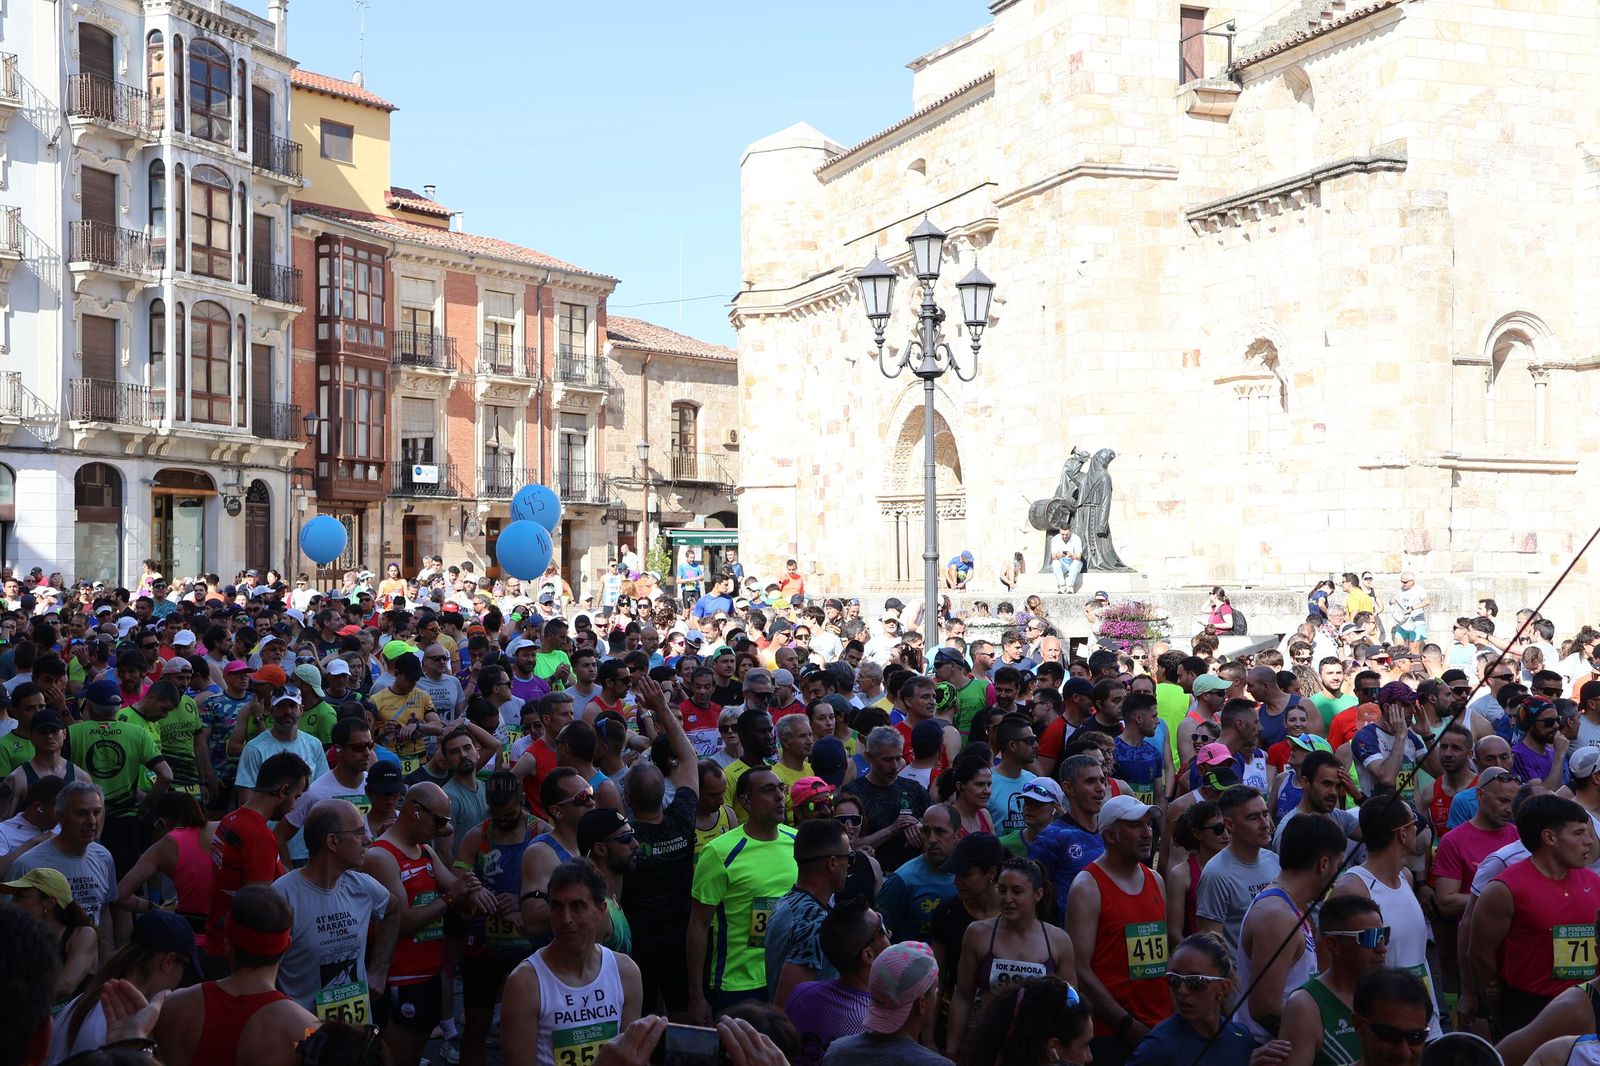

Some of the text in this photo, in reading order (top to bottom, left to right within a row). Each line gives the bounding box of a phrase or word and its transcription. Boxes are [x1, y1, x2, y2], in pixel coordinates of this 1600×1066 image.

[652, 839, 688, 855] RUNNING
[71, 882, 99, 891] ARATON
[328, 911, 352, 922] MEDIA
[487, 916, 520, 935] 39
[336, 928, 349, 937] 10K
[1133, 937, 1164, 961] 415
[1567, 940, 1589, 962] 71
[995, 963, 1043, 975] 10K ZAMORA
[565, 989, 605, 1008] E y D
[554, 1004, 618, 1025] PALENCIA
[560, 1044, 604, 1066] 35
